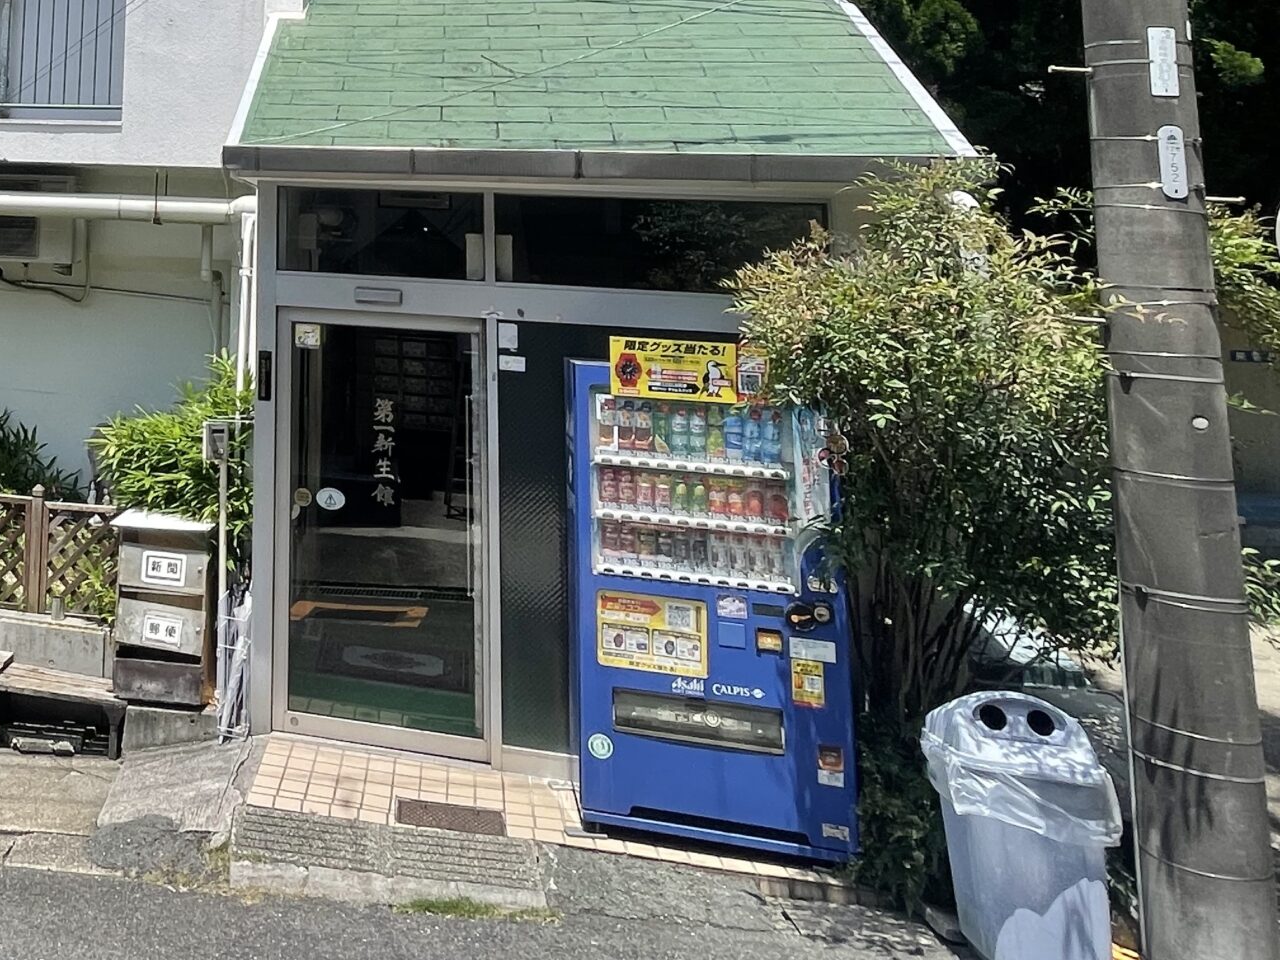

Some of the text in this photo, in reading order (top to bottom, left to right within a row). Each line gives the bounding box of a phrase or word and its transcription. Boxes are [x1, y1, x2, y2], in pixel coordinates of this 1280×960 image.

[1169, 152, 1180, 183] 752
[371, 398, 396, 507] 第一新生館
[151, 560, 178, 574] 新聞
[149, 622, 176, 638] 郵便
[672, 677, 704, 692] Asahi
[712, 683, 750, 697] CALPIS
